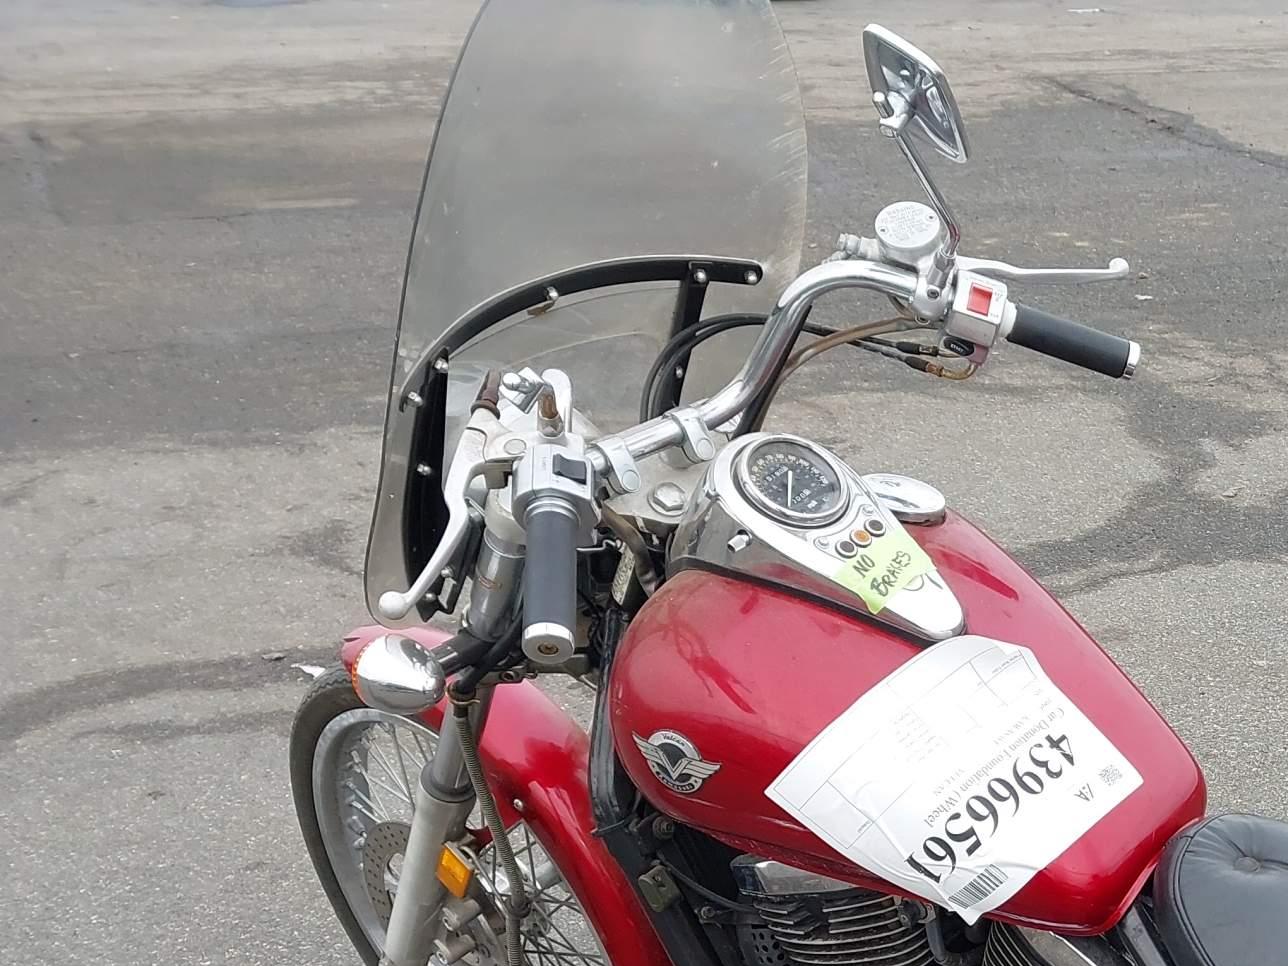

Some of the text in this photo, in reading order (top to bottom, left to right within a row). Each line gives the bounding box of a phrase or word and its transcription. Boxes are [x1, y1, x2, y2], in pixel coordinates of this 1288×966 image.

[852, 554, 876, 578] NO
[869, 550, 912, 598] BRAKES
[1008, 720, 1050, 752] Donation
[903, 733, 1076, 885] 43966561
